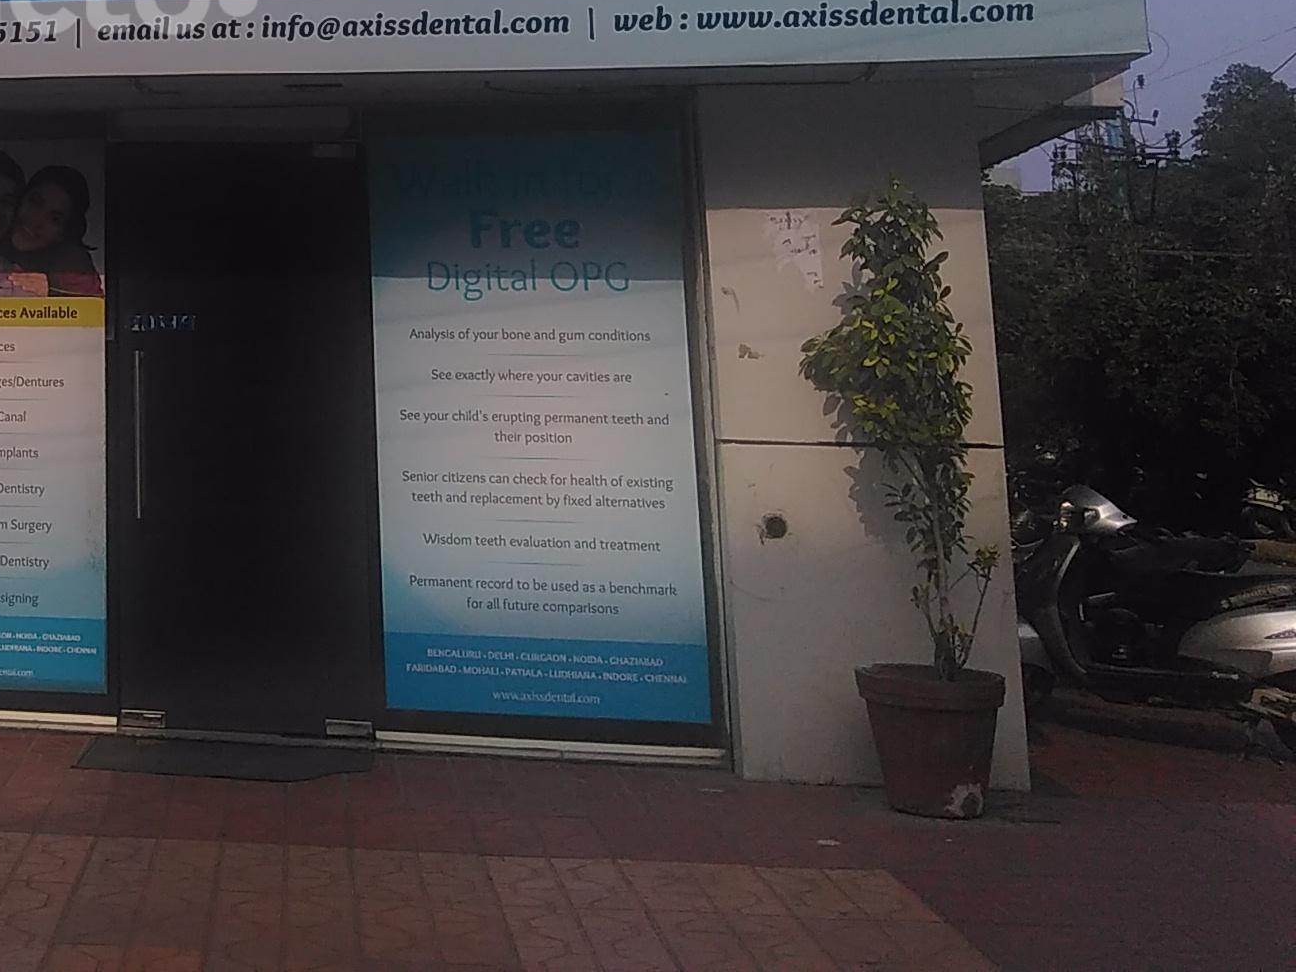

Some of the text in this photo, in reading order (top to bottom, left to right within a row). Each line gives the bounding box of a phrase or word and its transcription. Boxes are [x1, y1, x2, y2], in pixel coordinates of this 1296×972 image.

[97, 16, 171, 42] email
[176, 20, 205, 40] us
[262, 9, 570, 42] info@axissdental.com
[471, 212, 581, 249] Free
[428, 260, 629, 301] Digital OPG
[20, 307, 78, 319] Available
[409, 328, 651, 343] Analysis of your bone and gum conditions
[431, 369, 631, 384] See exactly where your cavities are
[400, 410, 420, 421] See
[423, 412, 449, 424] your
[492, 412, 541, 426] erupting
[544, 413, 608, 426] permanent
[612, 413, 644, 425] teeth
[647, 414, 669, 426] and
[495, 431, 572, 445] their position
[402, 471, 673, 491] Senior citizens can check for health of existing
[412, 491, 665, 509] teeth and replacement by fixed alternatives
[11, 519, 52, 533] Surgery
[423, 533, 660, 552] Wisdom teeth evaluation and treatment
[0, 555, 49, 570] Dentistry
[409, 575, 677, 596] Permanent record to be used as a benchmark
[466, 597, 619, 616] for all future comparisons
